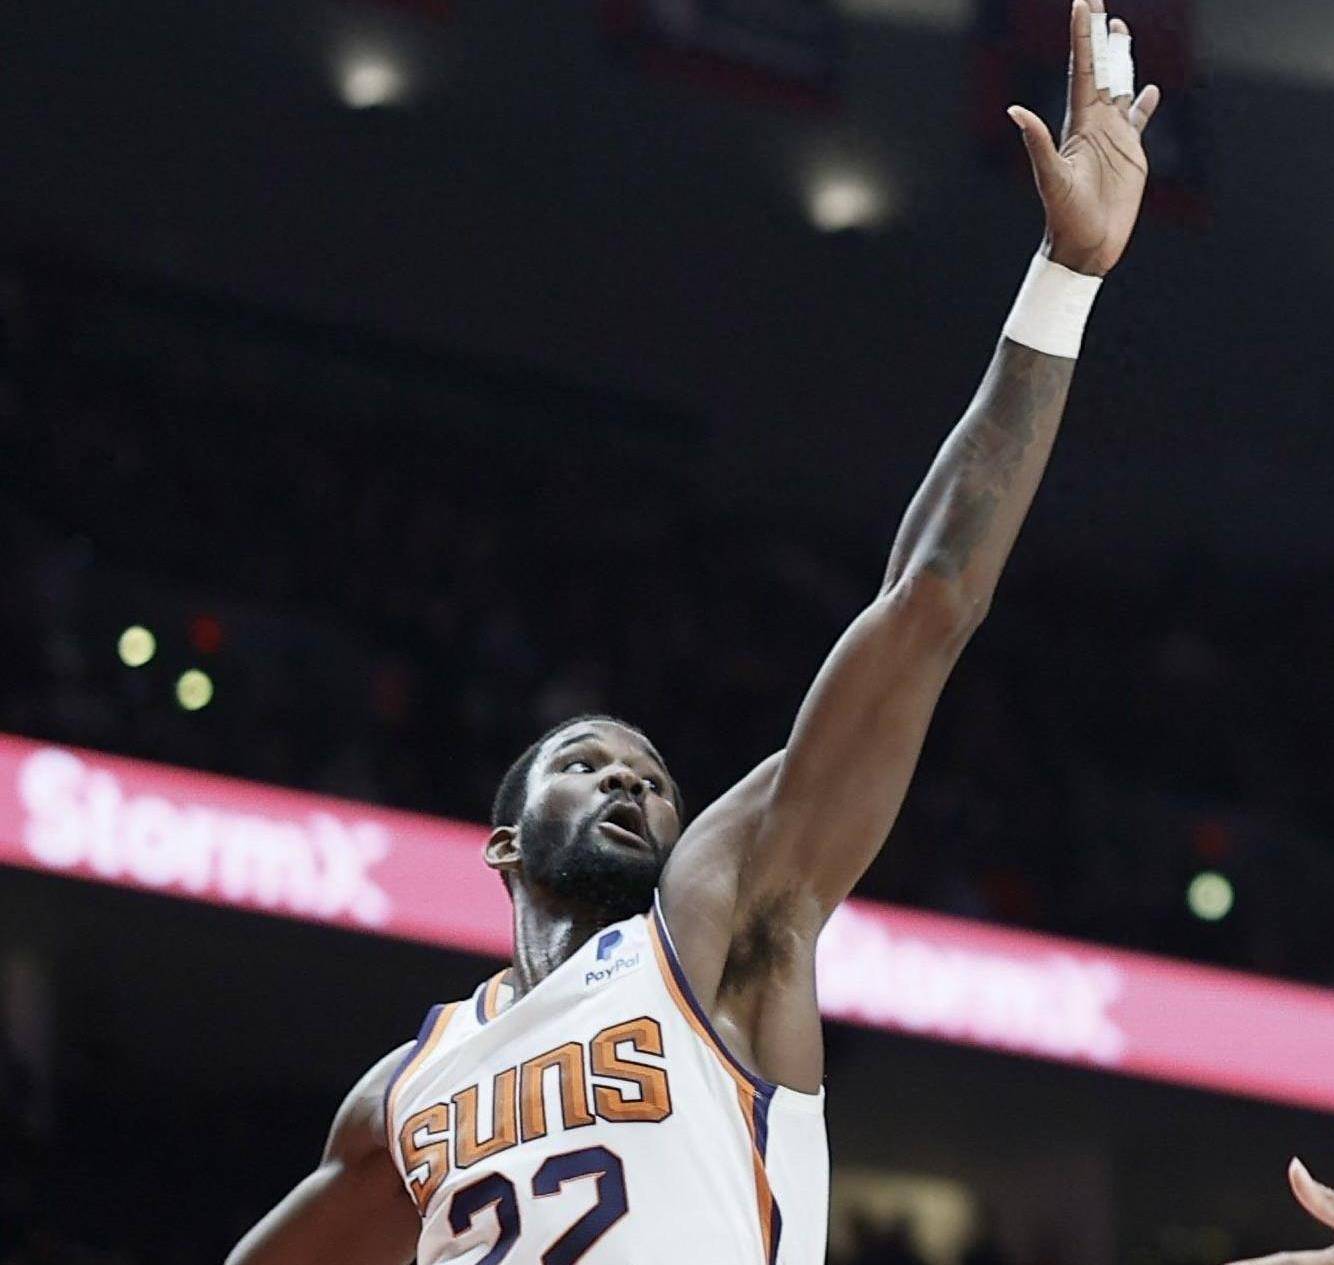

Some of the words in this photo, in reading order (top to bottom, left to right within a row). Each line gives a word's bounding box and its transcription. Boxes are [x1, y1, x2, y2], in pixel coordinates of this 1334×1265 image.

[19, 747, 393, 927] StormX
[585, 953, 640, 986] PayPal
[400, 1015, 673, 1218] SUNS
[448, 1144, 630, 1265] 22
